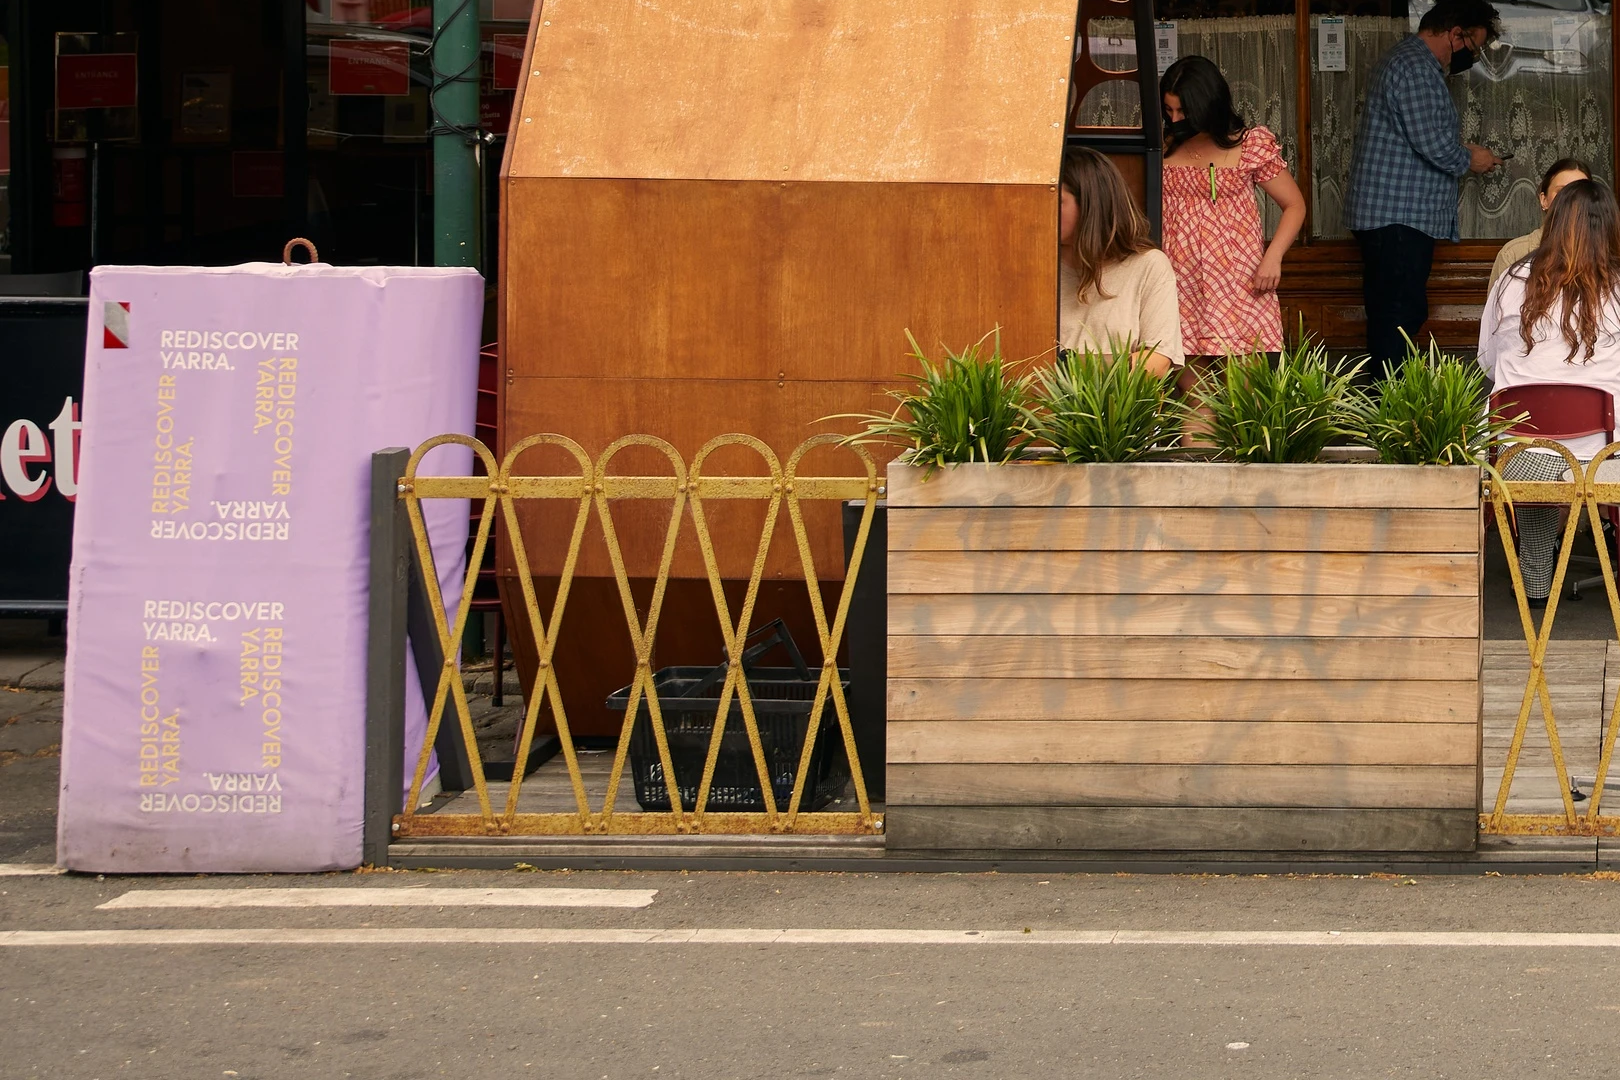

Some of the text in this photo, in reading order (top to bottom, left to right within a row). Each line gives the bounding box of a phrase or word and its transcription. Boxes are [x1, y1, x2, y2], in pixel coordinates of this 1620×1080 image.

[348, 56, 393, 65] ENTRANCE
[160, 330, 300, 351] REDISCOVER
[160, 351, 236, 371] YARRA.
[252, 357, 277, 435] YARRA.
[272, 357, 298, 496] REDISCOVER
[151, 374, 177, 514] REDISCOVER
[171, 436, 195, 515] YARRA.
[209, 500, 291, 520] YARRA.
[150, 520, 290, 541] REDISCOVER
[143, 600, 285, 621] REDISCOVER
[142, 621, 218, 642] YARRA.
[239, 627, 261, 708] YARRA.
[261, 627, 284, 770] REDISCOVER
[139, 645, 160, 788] REDISCOVER
[161, 707, 181, 788] YARRA.
[202, 772, 283, 792] YARRA.
[139, 792, 282, 813] REDISCOVER
